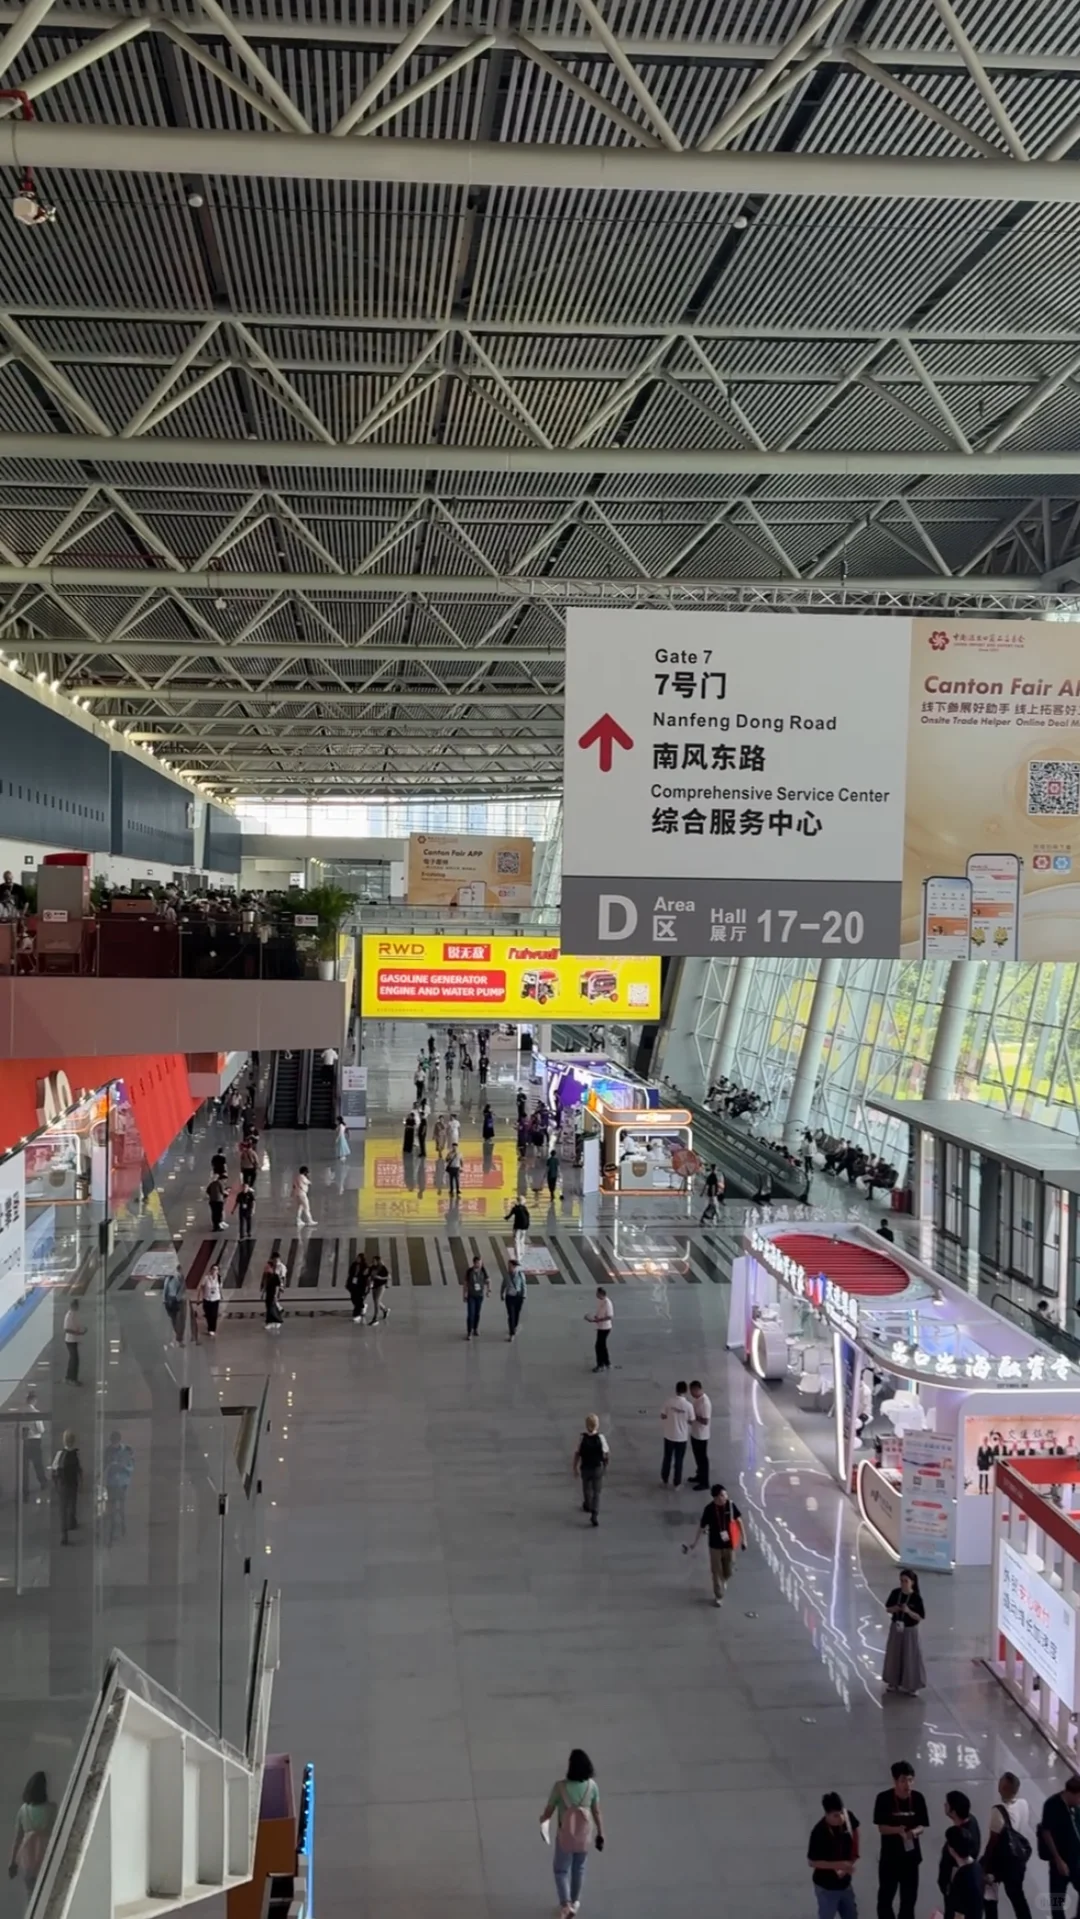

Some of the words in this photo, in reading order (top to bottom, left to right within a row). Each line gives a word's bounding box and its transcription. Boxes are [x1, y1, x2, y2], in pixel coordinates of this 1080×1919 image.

[655, 648, 698, 664] Gate
[703, 649, 713, 664] 7
[654, 671, 727, 700] 7号门
[924, 675, 1003, 695] Canton
[1010, 677, 1053, 697] Fair
[921, 700, 1010, 716] 线下参展好助手
[1014, 703, 1080, 717] 线上拓客好
[653, 711, 730, 732] Nanfeng
[736, 713, 784, 733] Dong
[789, 715, 837, 731] Road
[920, 715, 951, 725] Onsite
[952, 716, 979, 726] Trade
[980, 717, 1012, 728] Helper
[1015, 717, 1046, 727] Online
[1047, 718, 1069, 727] Deal
[1070, 719, 1080, 727] M
[653, 742, 767, 773] 南风东路
[650, 783, 773, 803] Comprehensive
[776, 786, 835, 802] Service
[838, 787, 891, 803] Center
[651, 806, 823, 837] 综合服务中心
[653, 896, 695, 912] Area
[598, 894, 638, 941] D
[710, 908, 747, 924] Hall
[652, 914, 678, 942] 区
[709, 924, 747, 942] 展厅
[378, 942, 425, 955] RWD
[380, 973, 429, 984] GASOLINE
[430, 974, 488, 985] GENERATOR
[380, 985, 416, 996] ENGINE
[417, 986, 441, 996] AND
[442, 986, 475, 997] WATER
[476, 987, 505, 997] PUMP
[891, 1340, 1080, 1382] 出口出海融资专
